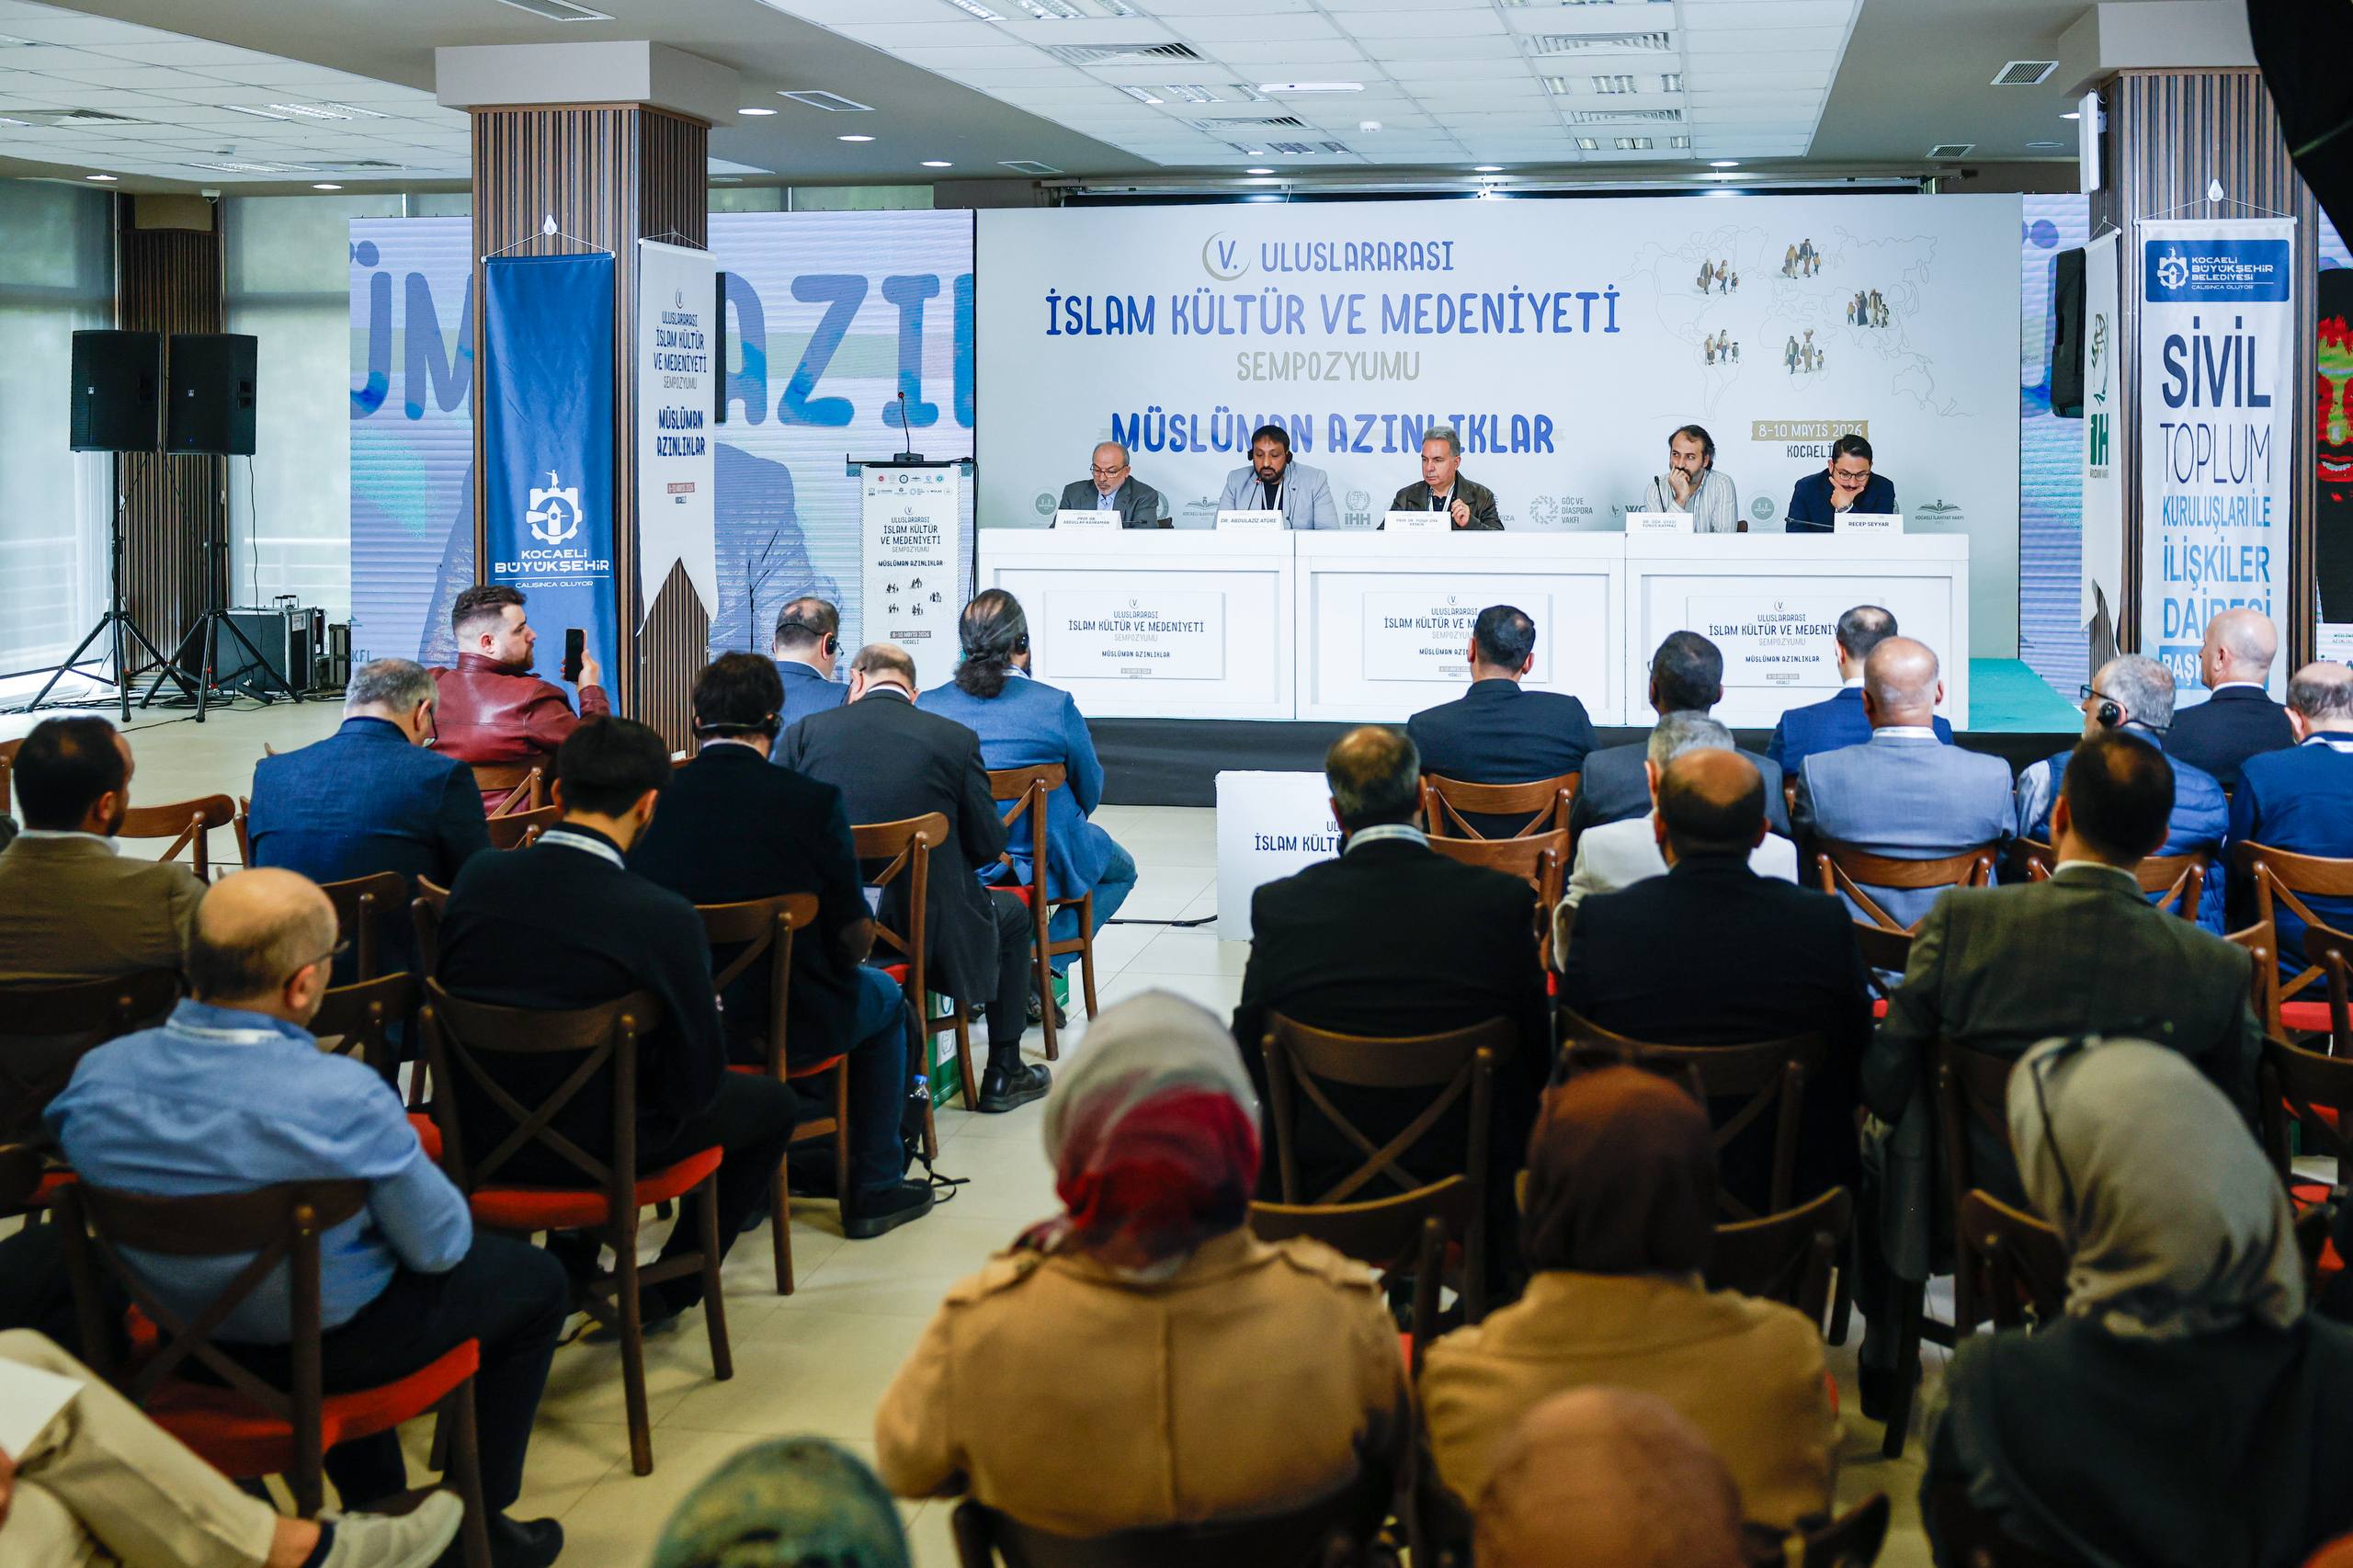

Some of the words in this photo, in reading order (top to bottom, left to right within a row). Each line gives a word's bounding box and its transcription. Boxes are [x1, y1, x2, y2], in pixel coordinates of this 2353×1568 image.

[1218, 240, 1238, 270] V.
[1261, 240, 1454, 272] ULUSLARARASI
[1046, 288, 1155, 335] İSLAM
[1172, 288, 1306, 335] KÜLTÜR
[1321, 293, 1367, 335] VE
[1381, 284, 1620, 334] MEDENİYETİ
[656, 326, 677, 347] İSLAM
[679, 328, 705, 349] KÜLTÜR
[726, 272, 972, 427] AZI
[654, 353, 663, 369] VE
[665, 352, 707, 372] MEDENİYETİ
[1237, 351, 1419, 381] SEMPOZYUMU
[2162, 316, 2271, 408] SİVİL
[658, 405, 703, 429] MÜSLÜMAN
[1759, 424, 1788, 437] 8-10
[1791, 424, 1827, 437] MAYIS
[657, 436, 705, 456] AZINLIKLAR
[2160, 423, 2270, 483] TOPLUM
[2163, 495, 2248, 535] KURULUŞLARI
[2252, 489, 2271, 528] İLE
[881, 536, 891, 544] VE
[892, 535, 941, 545] MEDENİYETİ
[883, 523, 907, 534] İSLAM
[909, 524, 938, 534] KÜLTÜR
[2164, 536, 2270, 591] İLİŞKİLER
[1069, 619, 1096, 631] İSLAM
[1099, 619, 1131, 631] KÜLTÜR
[1134, 621, 1145, 631] VE
[1149, 619, 1204, 632] MEDENİYETİ
[1384, 616, 1412, 629] İSLAM
[1415, 616, 1449, 629] KÜLTÜR
[1452, 619, 1464, 629] VE
[1709, 623, 1738, 636] İSLAM
[1742, 623, 1777, 635] KÜLTÜR
[1779, 625, 1791, 635] VE
[1255, 833, 1297, 851] İSLAM
